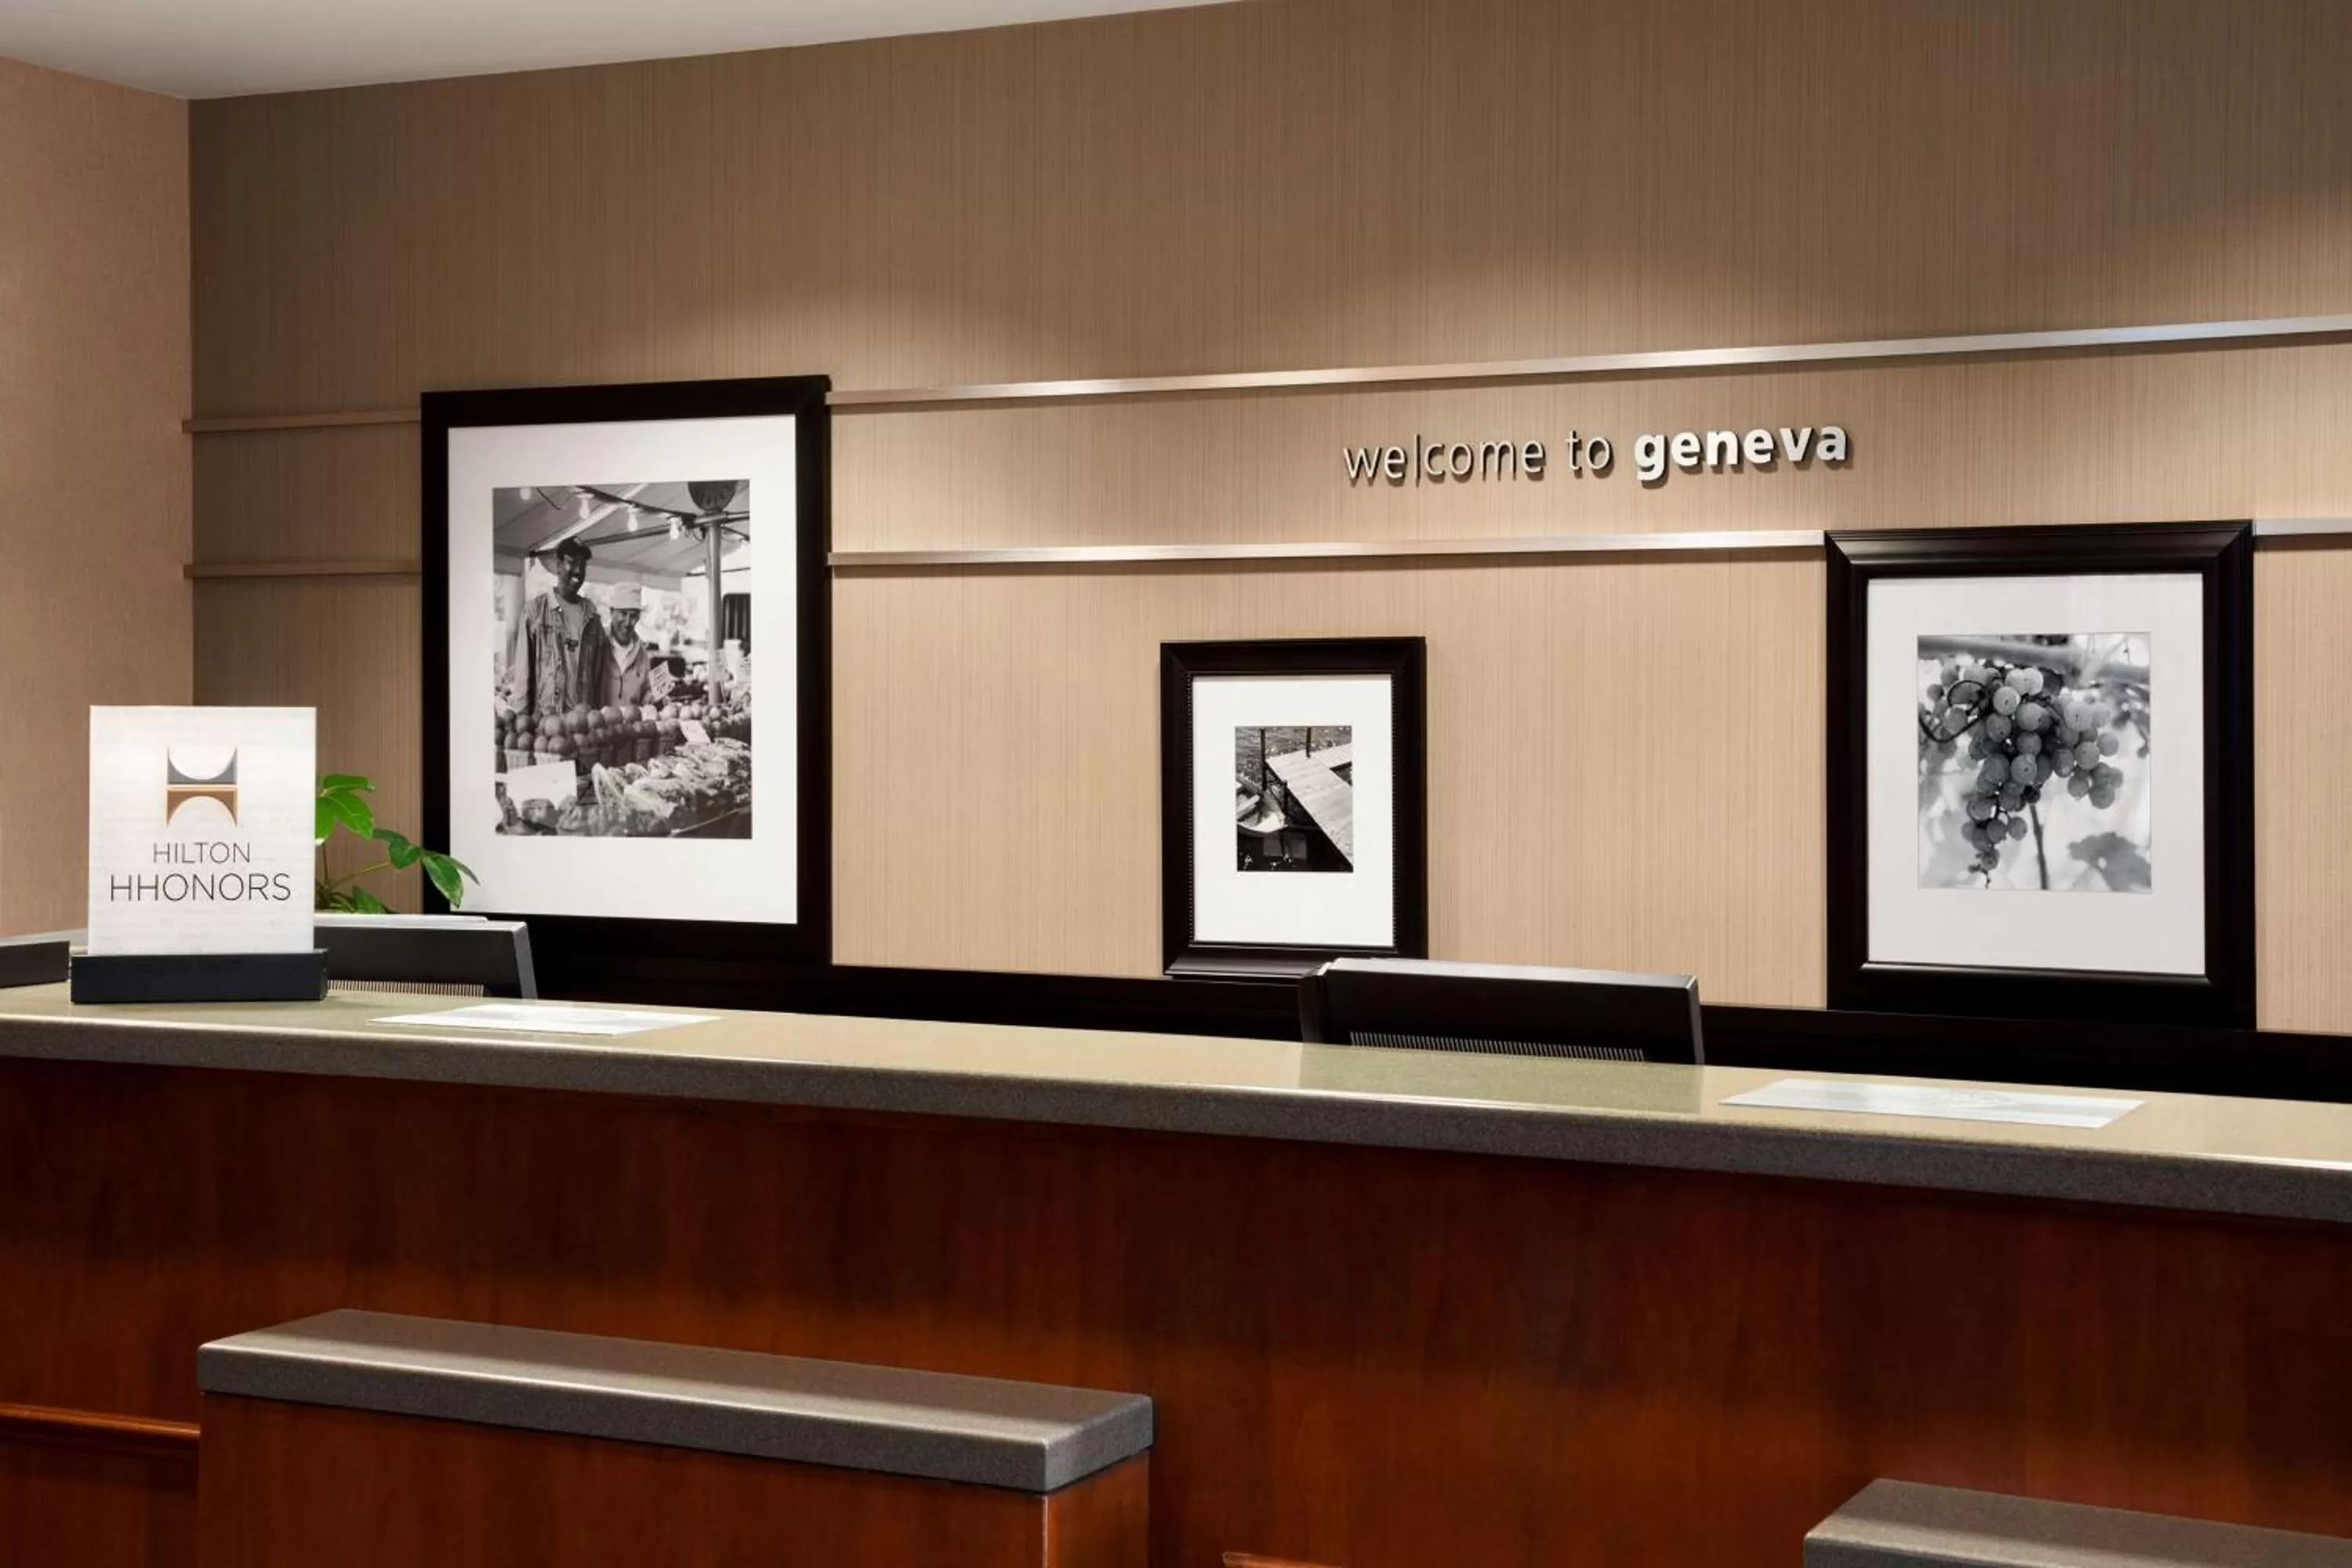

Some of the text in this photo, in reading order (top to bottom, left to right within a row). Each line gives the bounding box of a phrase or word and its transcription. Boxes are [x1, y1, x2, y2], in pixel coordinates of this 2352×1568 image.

[1344, 425, 1848, 481] welcome to geneva
[153, 841, 250, 864] HILTON
[111, 873, 291, 902] HHONORS
